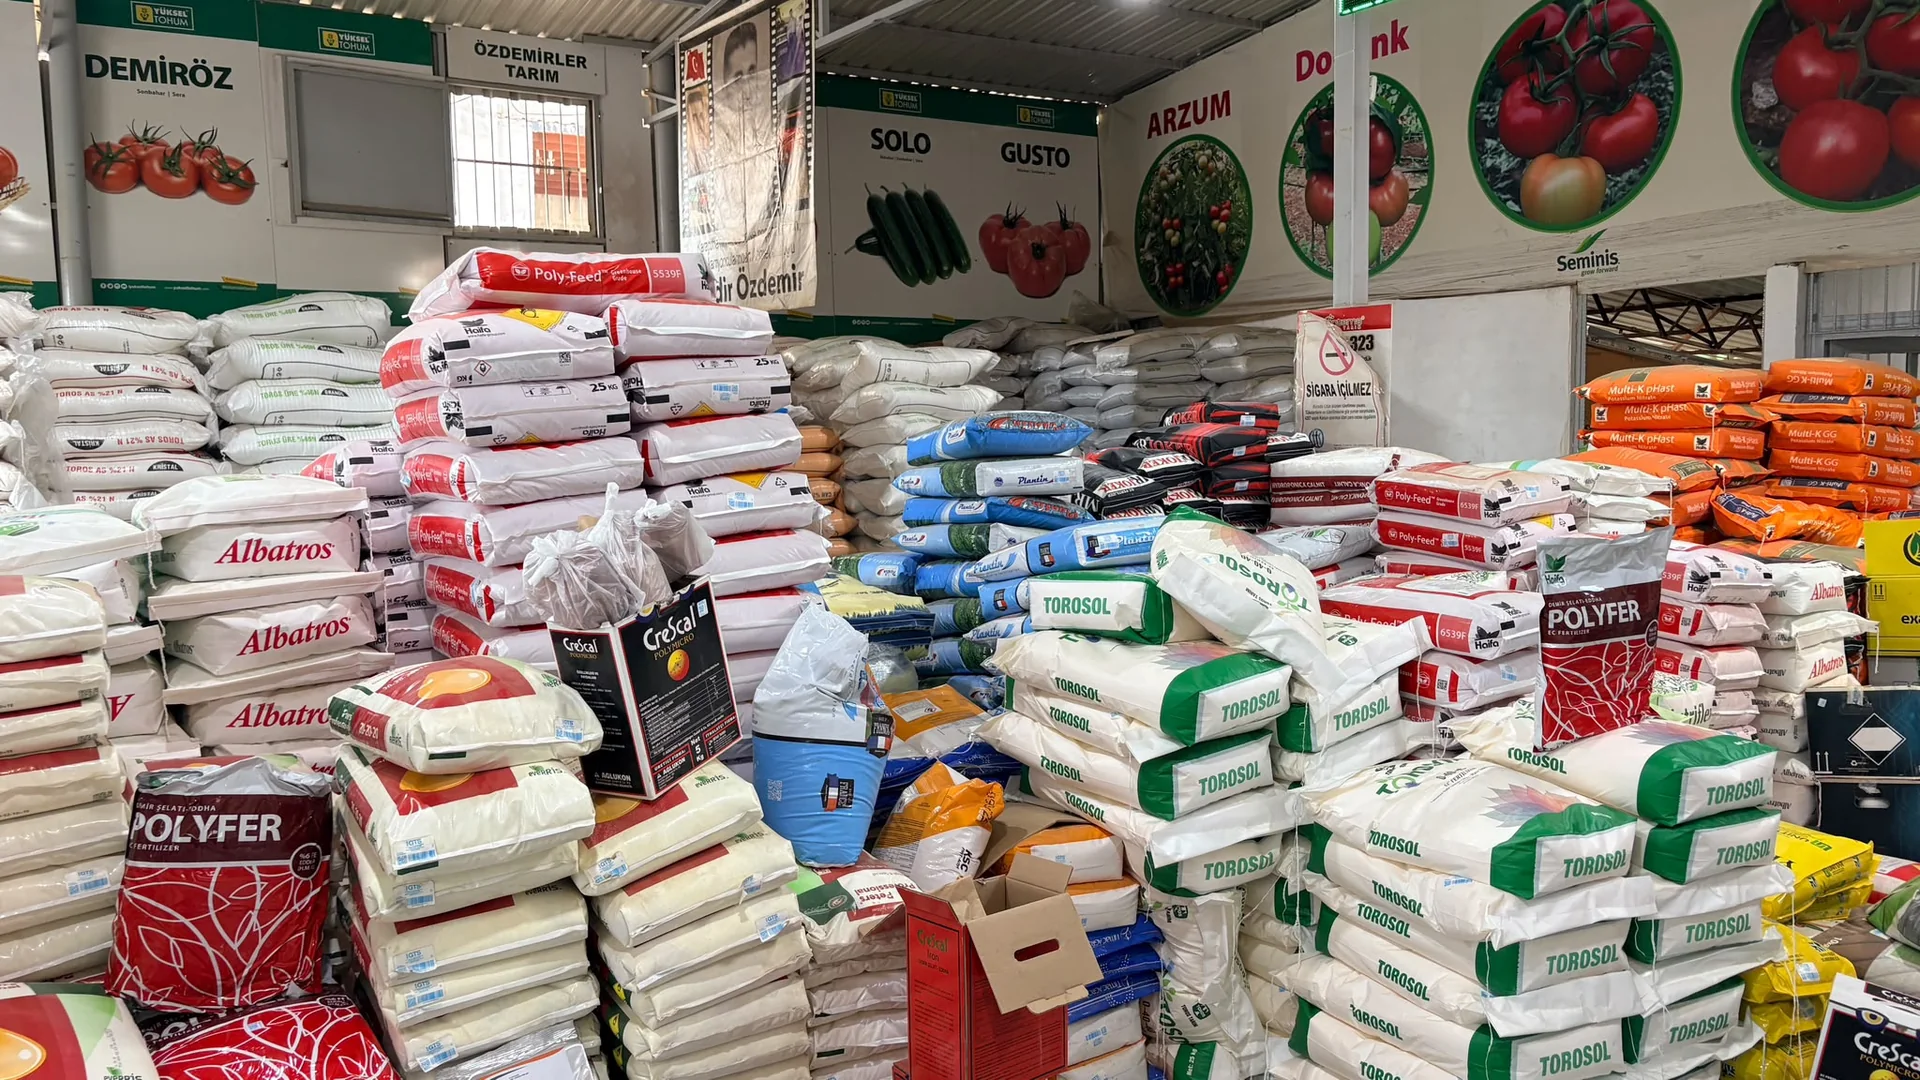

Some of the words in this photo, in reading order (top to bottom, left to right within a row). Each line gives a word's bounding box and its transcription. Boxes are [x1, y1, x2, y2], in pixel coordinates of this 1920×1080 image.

[153, 6, 188, 18] YÜKSEL
[153, 15, 189, 27] TOHUM
[338, 33, 370, 45] YÜKSEL
[338, 41, 371, 52] TOHUM
[474, 39, 587, 69] ÖZDEMİRLER
[1296, 19, 1409, 82] Donk
[84, 54, 233, 90] DEMİRÖZ
[505, 64, 559, 83] TARIM
[893, 100, 918, 110] TOHUM
[894, 92, 918, 102] YÜKSEL
[1147, 90, 1231, 139] ARZUM
[871, 128, 931, 154] SOLO
[1000, 142, 1070, 168] GUSTO
[1557, 249, 1619, 271] Seminis
[534, 266, 603, 284] Poly-Feed
[1581, 269, 1595, 277] grow
[1596, 266, 1619, 274] forward
[715, 281, 733, 303] dir
[737, 264, 804, 301] Özdemir
[464, 324, 491, 335] Haifa
[1350, 334, 1374, 351] 323
[754, 358, 770, 366] 25
[589, 382, 607, 393] 25
[608, 383, 619, 391] KG
[1786, 375, 1801, 383] GG
[1801, 377, 1834, 386] Multi-K
[56, 390, 83, 398] TOROS
[1306, 381, 1337, 398] SİGARA
[1337, 380, 1372, 400] İÇİLMEZ
[1608, 384, 1645, 395] Multi-K
[1645, 383, 1676, 395] pHast
[750, 400, 771, 408] Haifa
[1624, 404, 1659, 415] Multi-K
[1660, 403, 1689, 413] pHast
[126, 436, 144, 445] %21
[158, 436, 185, 444] TOROS
[582, 428, 606, 436] Haifa
[1609, 433, 1645, 443] Multi-K
[1646, 434, 1675, 444] pHast
[1788, 429, 1822, 438] Multi-K
[1824, 430, 1838, 438] GG
[95, 466, 107, 474] AS
[1789, 456, 1823, 465] Multi-K
[1824, 458, 1839, 466] GG
[1018, 475, 1048, 485] Plantin
[687, 486, 711, 495] Haifa
[1395, 490, 1432, 506] Poly-Feed
[383, 498, 407, 506] Haifa
[1398, 532, 1435, 547] Poly-Feed
[214, 537, 334, 565] Albatros
[389, 555, 412, 564] Haifa
[1544, 573, 1566, 586] Haifa
[1810, 583, 1844, 601] Albatros
[404, 600, 428, 608] Haifa
[1043, 596, 1111, 616] TOROSOL
[1547, 599, 1642, 630] POLYFER
[236, 615, 351, 657] Albatros
[643, 604, 697, 651] CreScal
[972, 626, 1001, 640] Plantin
[404, 640, 419, 649] 25
[563, 637, 598, 654] CreScal
[653, 633, 696, 661] POLYMICRO
[1475, 639, 1500, 650] Haifa
[1809, 654, 1844, 679] Albatros
[1055, 677, 1102, 703] TOROSOL
[1221, 688, 1281, 723] TOROSOL
[1333, 695, 1391, 732] TOROSOL
[1049, 706, 1092, 734] TOROSOL
[358, 721, 379, 739] 20-20-20
[691, 736, 701, 746] Net
[695, 744, 701, 754] 5
[662, 757, 686, 775] AGLUKON
[1507, 747, 1567, 775] TOROSOL
[601, 771, 632, 782] AGLUKON
[1198, 760, 1261, 797] TOROSOL
[1707, 777, 1766, 806] TOROSOL
[1065, 791, 1106, 824] TOROSOL
[130, 812, 282, 844] POLYFER
[1368, 830, 1421, 858] TOROSOL
[960, 849, 973, 872] KSC
[1717, 838, 1772, 869] TOROSOL
[1204, 852, 1275, 881] TOROSOL
[1564, 848, 1628, 878] TOROSOL
[860, 891, 894, 902] Peters
[1371, 880, 1424, 918] TOROSOL
[1357, 903, 1411, 938] TOROSOL
[1685, 912, 1752, 943] TOROSOL
[917, 929, 949, 953] CreScal
[1546, 943, 1619, 976] TOROSOL
[1377, 959, 1430, 1001] TOROSOL
[1882, 990, 1920, 1006] CreSca
[1669, 1012, 1730, 1044] TOROSOL
[1540, 1041, 1612, 1077] TOROSOL
[1854, 1032, 1920, 1071] CreSca
